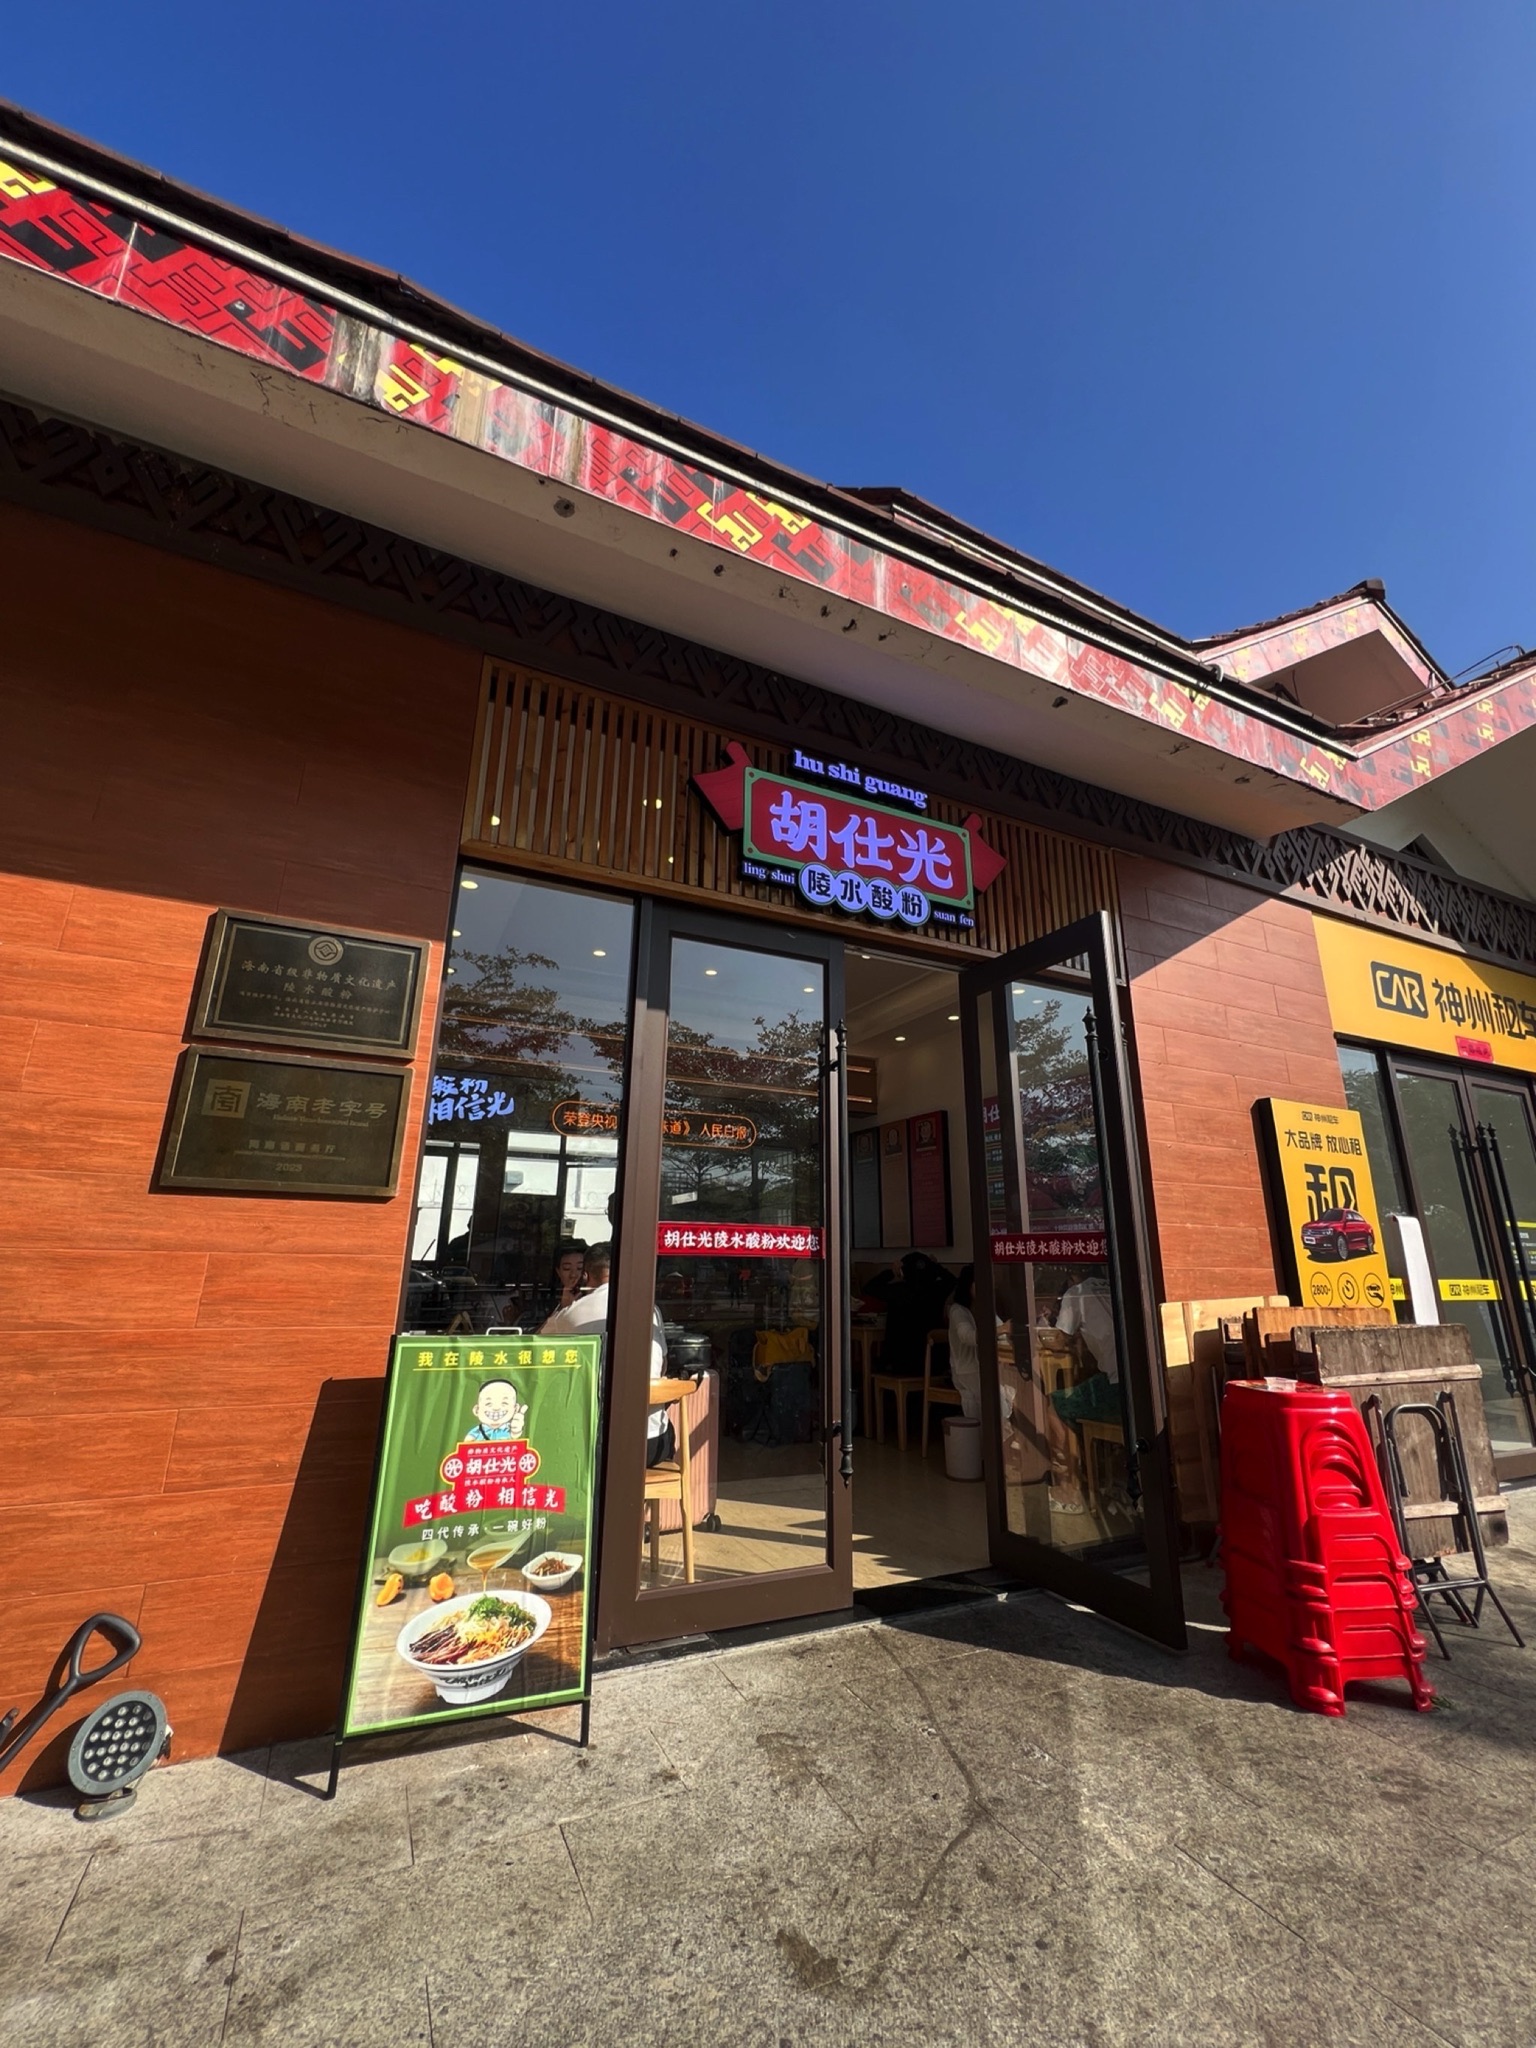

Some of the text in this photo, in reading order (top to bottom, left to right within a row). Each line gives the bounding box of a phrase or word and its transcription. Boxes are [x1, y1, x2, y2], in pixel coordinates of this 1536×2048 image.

[793, 750, 928, 809] hu shi guang
[769, 790, 954, 890] 胡仕光
[743, 862, 796, 884] ling shui
[807, 869, 924, 918] 陵水酸粉
[933, 910, 975, 928] suan fen
[255, 1092, 389, 1120] 海南老字号
[1284, 1129, 1363, 1157] 大品牌 放心租
[663, 1230, 820, 1252] 胡仕光陵水酸粉欢迎您
[417, 1350, 579, 1368] 我在陵水很想您
[465, 1455, 517, 1476] 胡仕光
[414, 1486, 560, 1521] 吃酸粉 相信光
